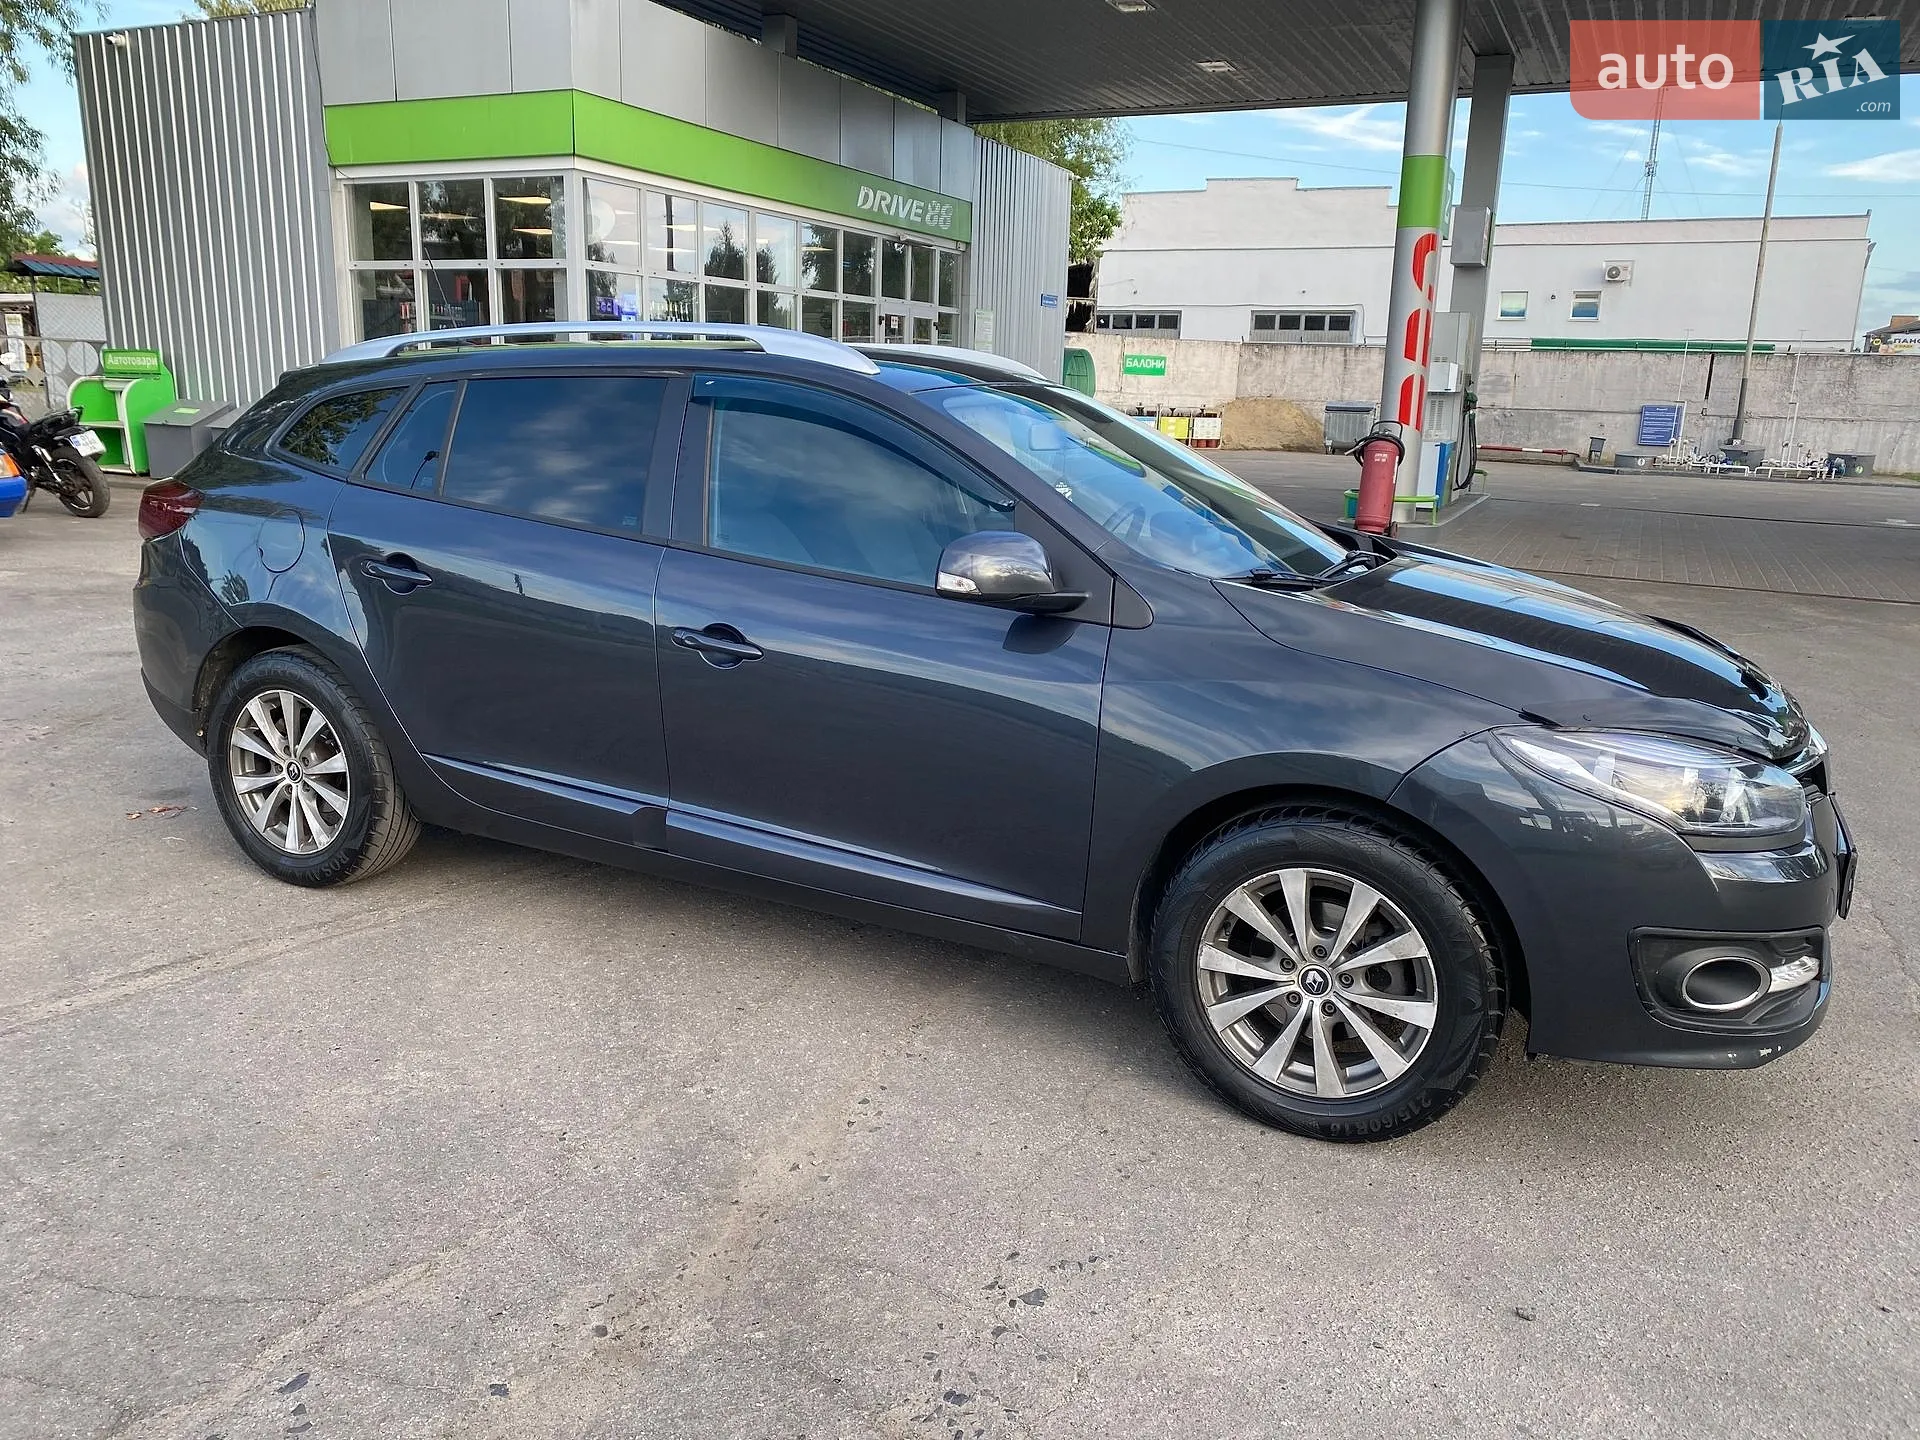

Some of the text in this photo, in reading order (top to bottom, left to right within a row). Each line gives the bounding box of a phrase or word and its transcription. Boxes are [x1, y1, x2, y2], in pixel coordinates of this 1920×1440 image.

[857, 186, 952, 229] DRIVE 88
[107, 353, 158, 369] Автотовари
[1126, 357, 1165, 368] БАЛОНИ
